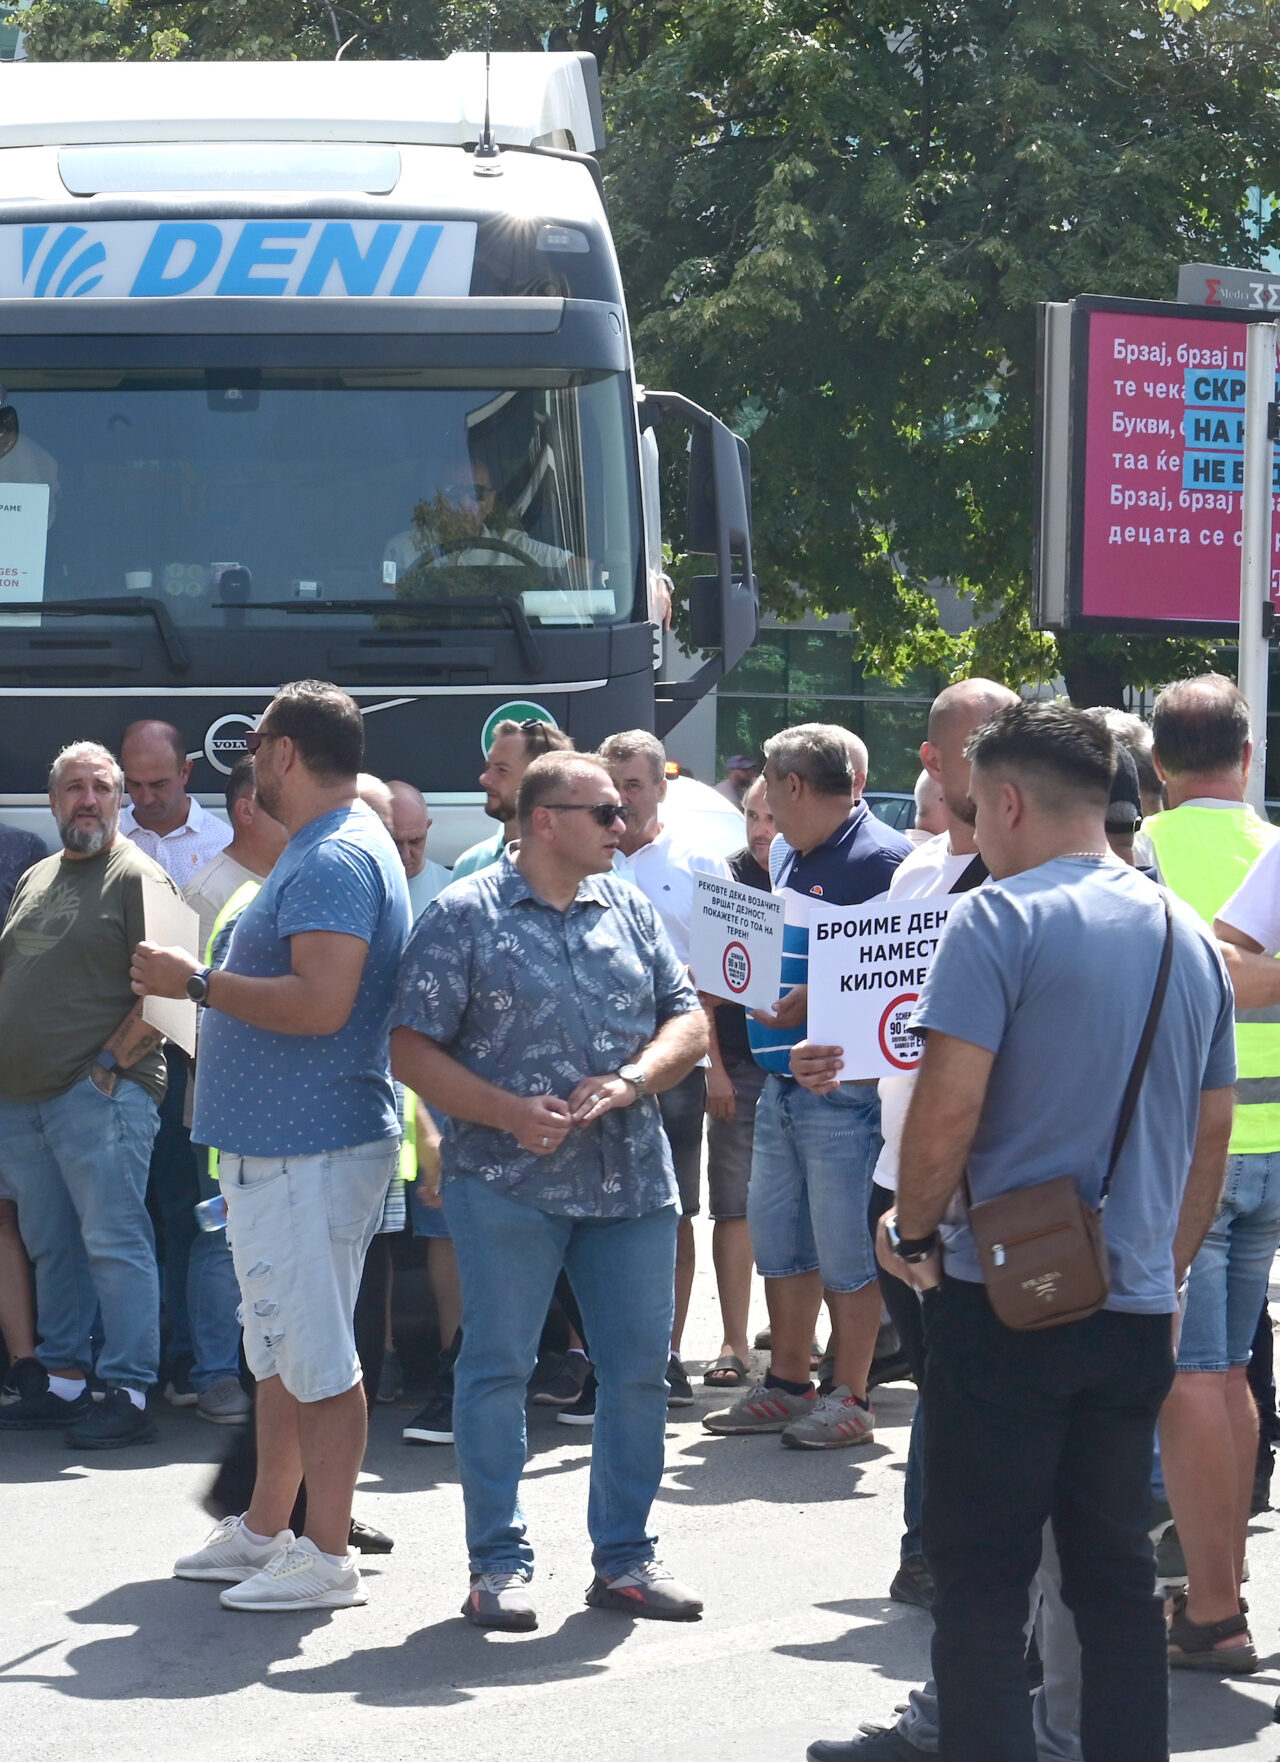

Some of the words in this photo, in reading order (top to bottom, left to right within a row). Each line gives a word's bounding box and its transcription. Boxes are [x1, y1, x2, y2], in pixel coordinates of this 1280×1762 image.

[128, 223, 444, 297] DENI
[1113, 338, 1172, 367] Брзај,
[1176, 343, 1228, 370] брзај
[1113, 380, 1137, 396] те
[1112, 411, 1176, 440] Букви,
[1194, 418, 1230, 443] НА
[1112, 452, 1148, 470] таа
[1156, 449, 1181, 472] ќе
[1193, 459, 1225, 483] НЕ
[1110, 483, 1173, 512] Брзај,
[1179, 489, 1233, 514] брзај
[1108, 525, 1191, 546] децата
[1199, 529, 1225, 546] се
[698, 880, 728, 896] РЕКОВТЕ
[728, 889, 747, 901] ДЕКА
[747, 895, 780, 914] ВОЗАЧИТЕ
[711, 896, 735, 910] ВРШАТ
[736, 904, 767, 923] ДЕЈНОСТ,
[703, 906, 738, 925] ПОКАЖЕТЕ
[740, 917, 749, 927] ГО
[750, 921, 763, 932] ТОА
[764, 926, 773, 936] НА
[726, 925, 750, 940] ТЕРЕН!
[816, 915, 902, 940] БРОИМЕ
[907, 910, 948, 935] ДЕН
[859, 938, 939, 963] НАМЕСТ
[840, 967, 927, 992] КИЛОМЕ
[890, 1022, 901, 1035] 90
